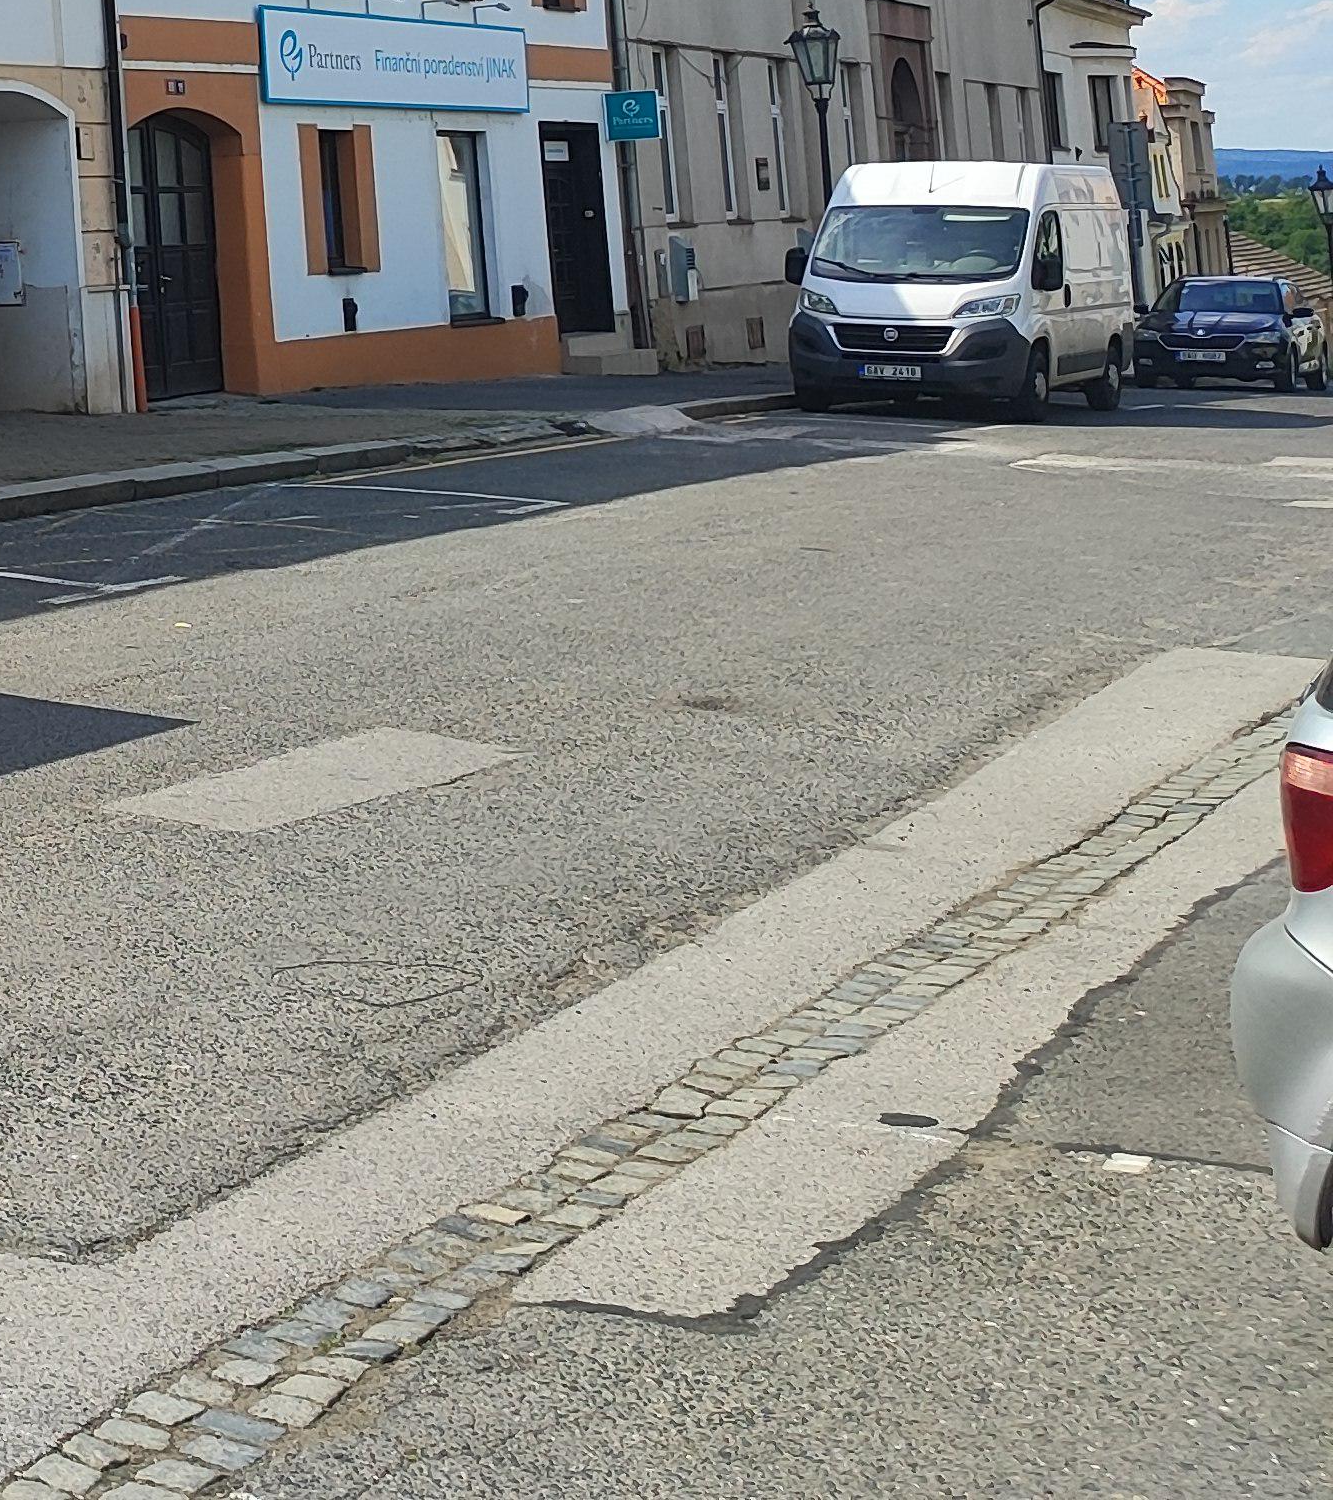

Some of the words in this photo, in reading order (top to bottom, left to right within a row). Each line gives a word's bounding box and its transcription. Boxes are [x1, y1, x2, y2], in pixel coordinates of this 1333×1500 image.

[307, 43, 362, 72] Partners
[374, 49, 422, 74] Finanční
[423, 54, 484, 80] poradenství
[485, 56, 517, 83] JINAK
